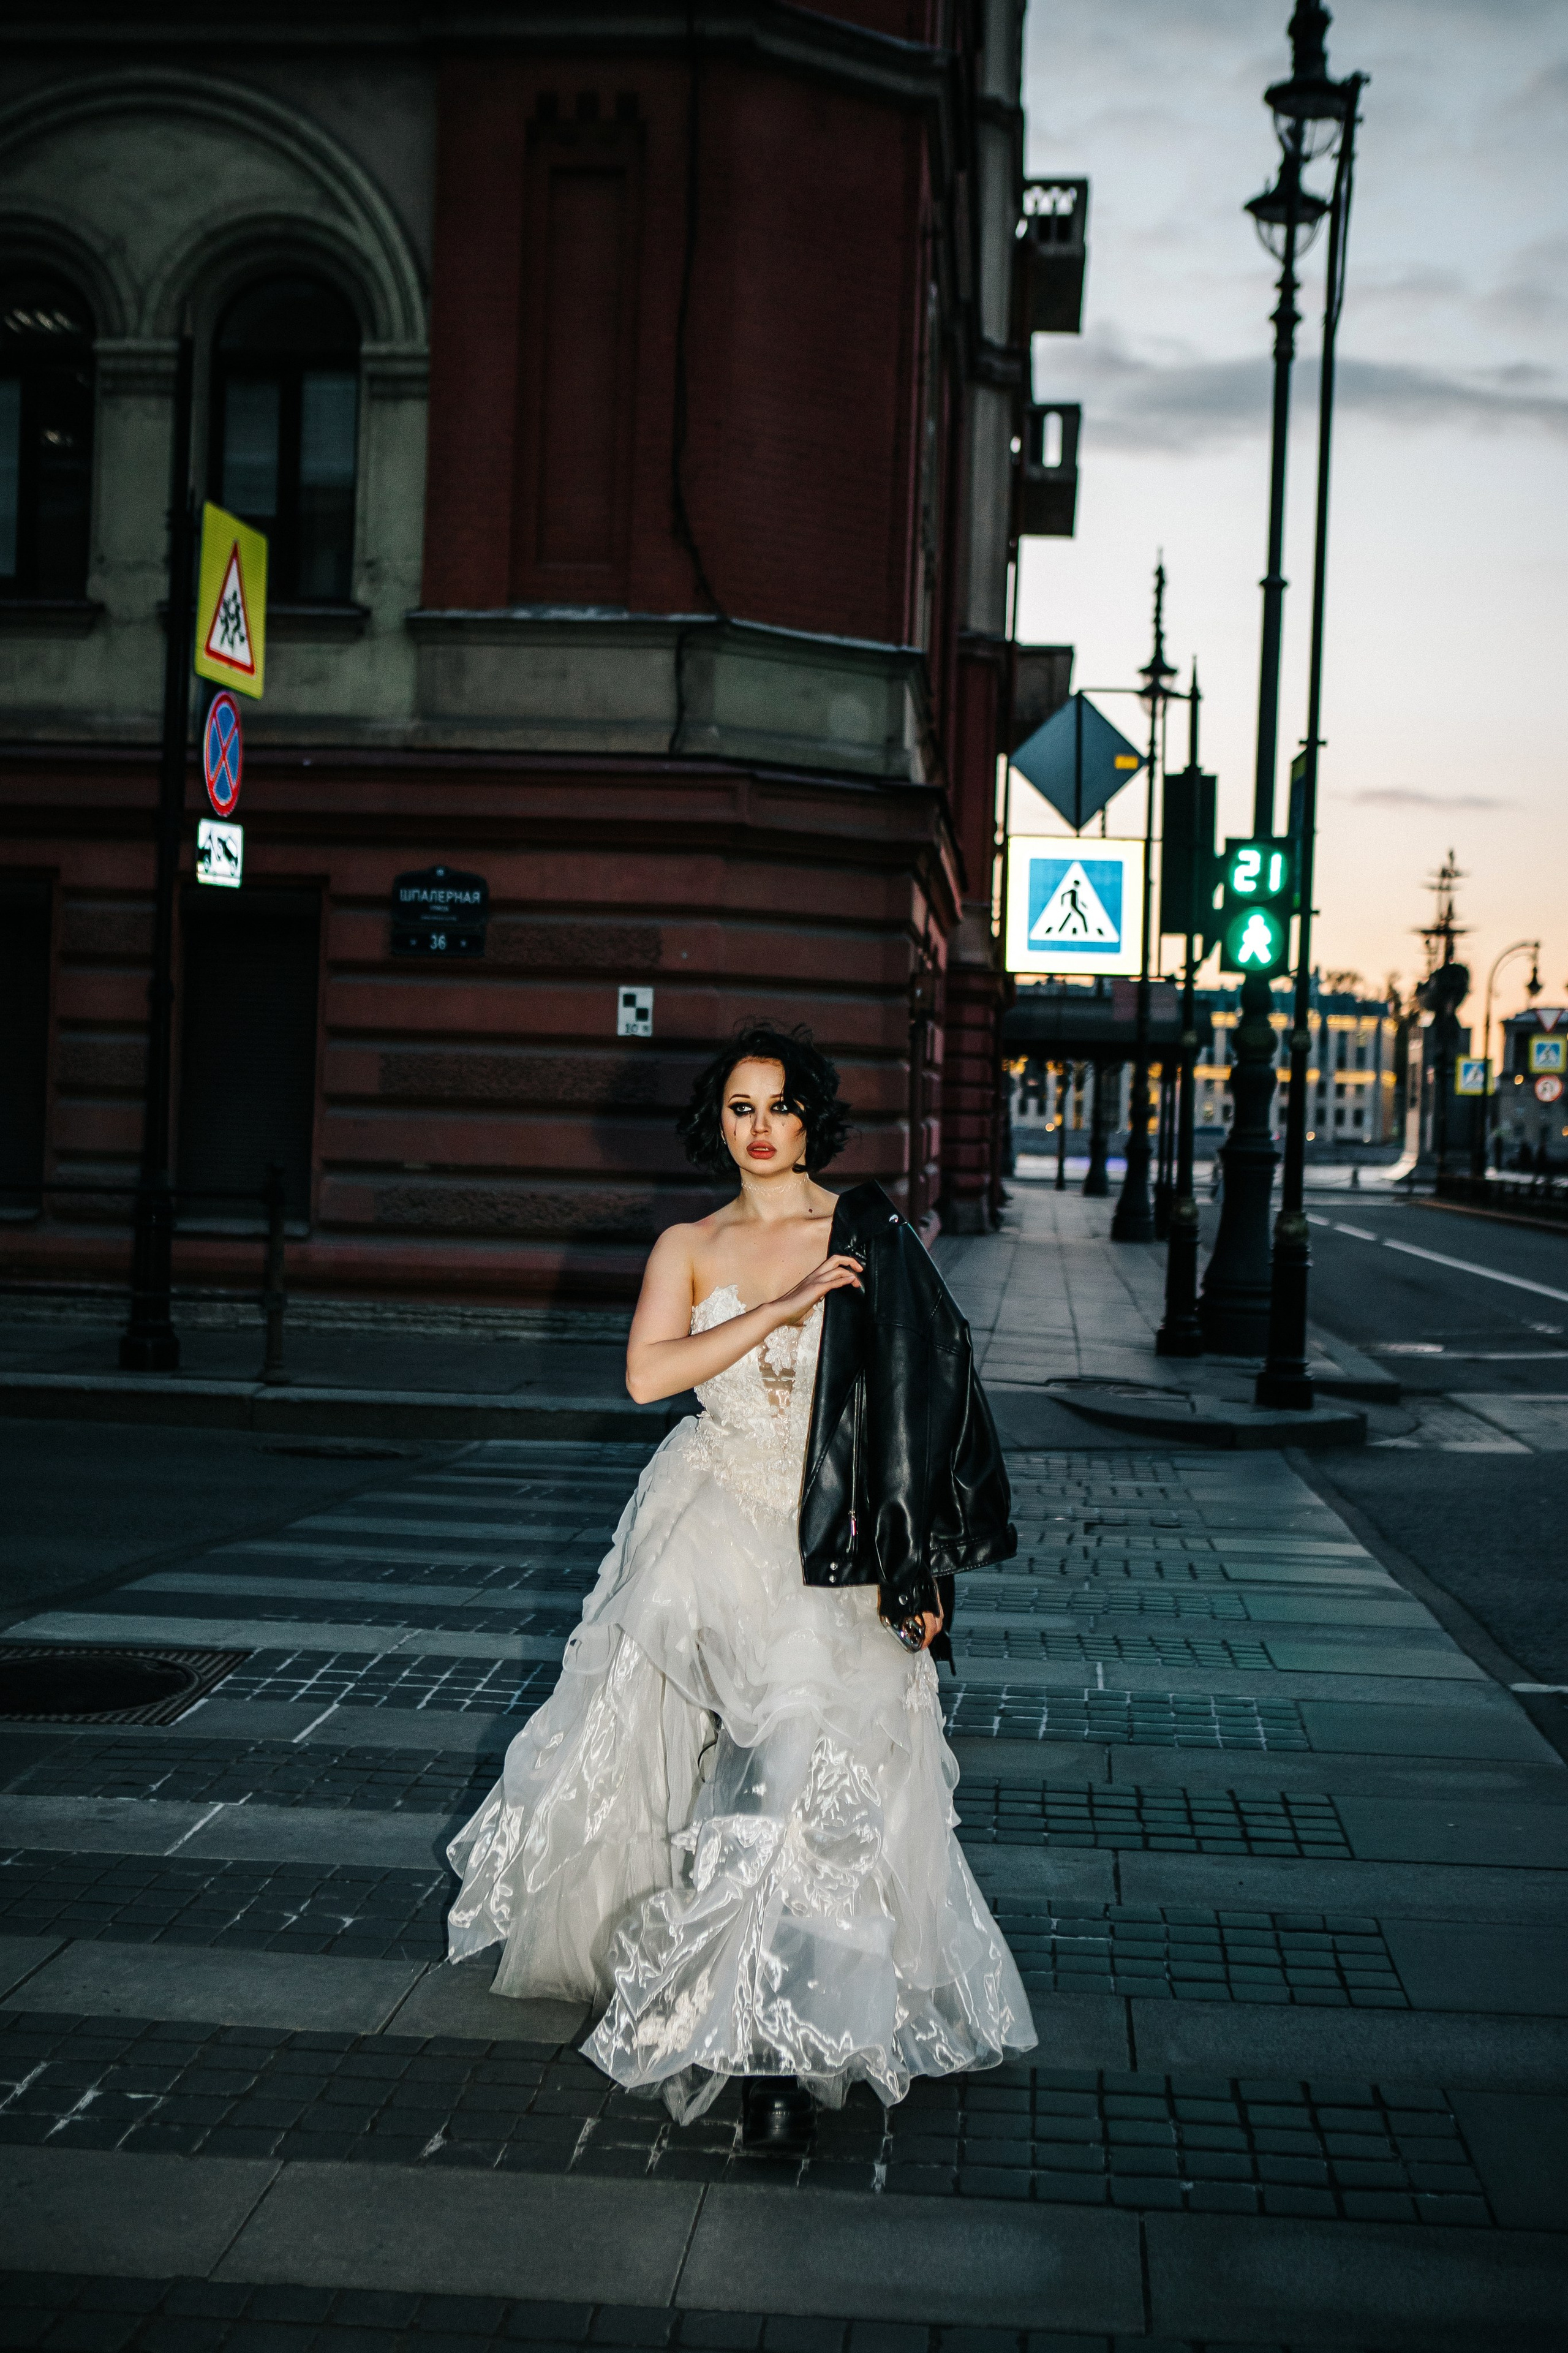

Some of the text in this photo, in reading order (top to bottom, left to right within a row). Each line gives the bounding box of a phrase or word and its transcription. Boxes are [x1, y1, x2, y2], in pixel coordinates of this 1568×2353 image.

[1234, 850, 1282, 892] 21
[400, 889, 480, 904] ШПАЛЕРНАЯ
[431, 934, 447, 950] 36
